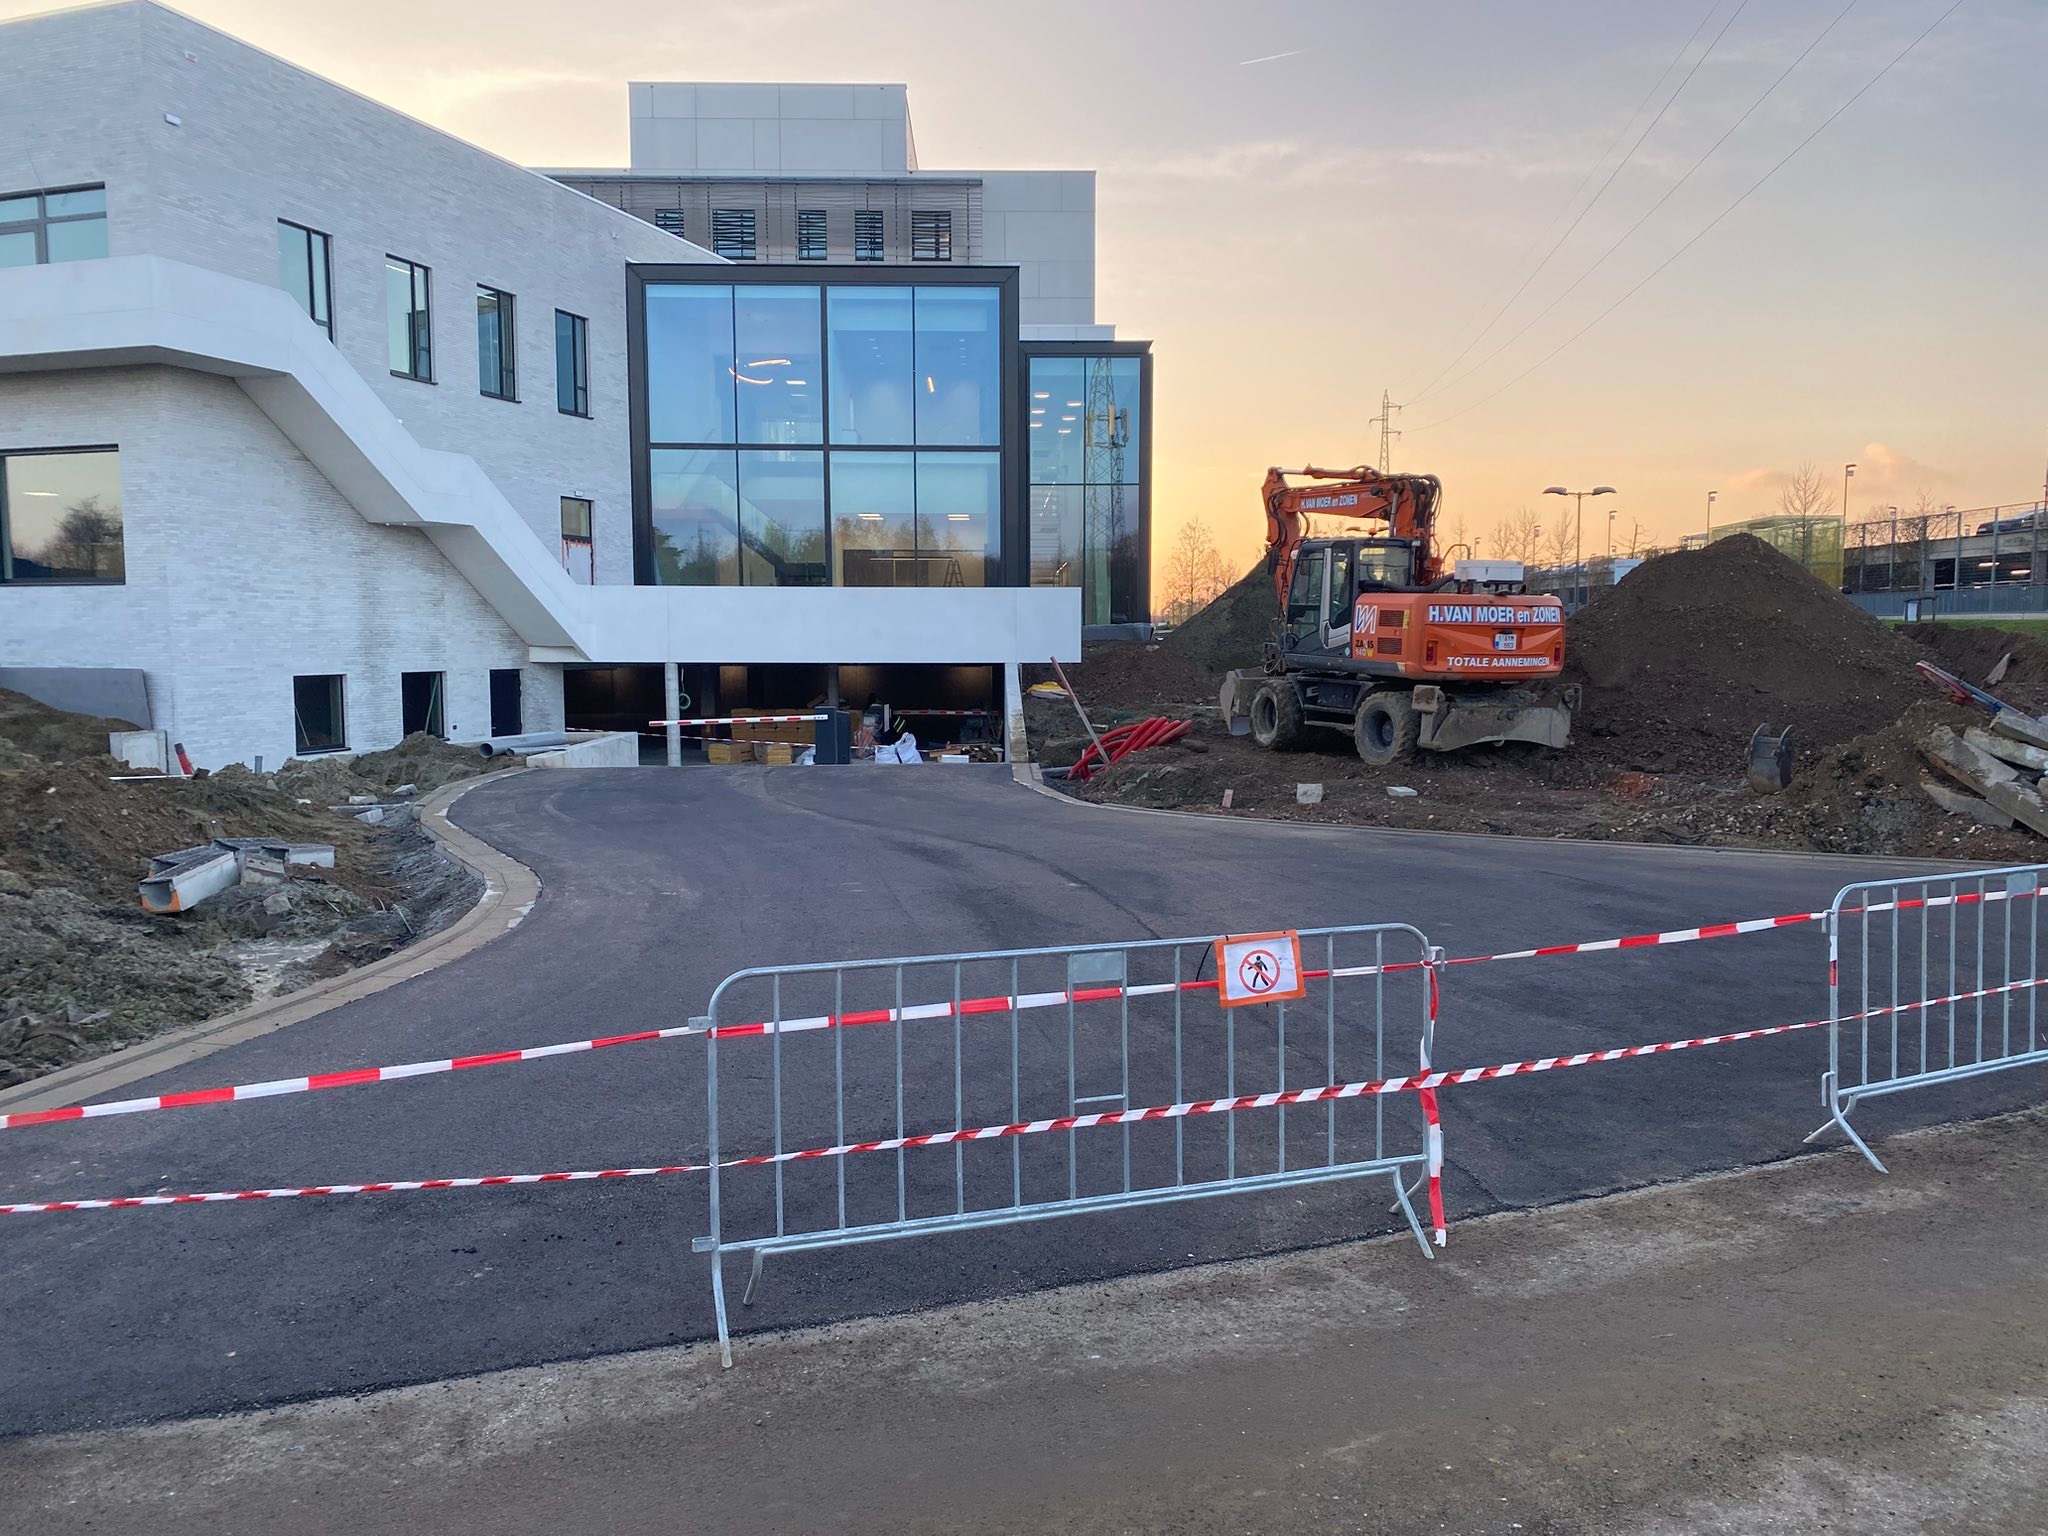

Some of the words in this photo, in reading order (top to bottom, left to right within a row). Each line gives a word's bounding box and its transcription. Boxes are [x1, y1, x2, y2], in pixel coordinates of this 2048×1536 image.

[1429, 605, 1473, 623] H.VAN
[1476, 606, 1515, 623] MOER
[1517, 609, 1531, 623] en
[1532, 606, 1561, 623] ZONEN
[1447, 656, 1490, 667] TOTALE
[1491, 657, 1550, 667] AANNEMINGEN
